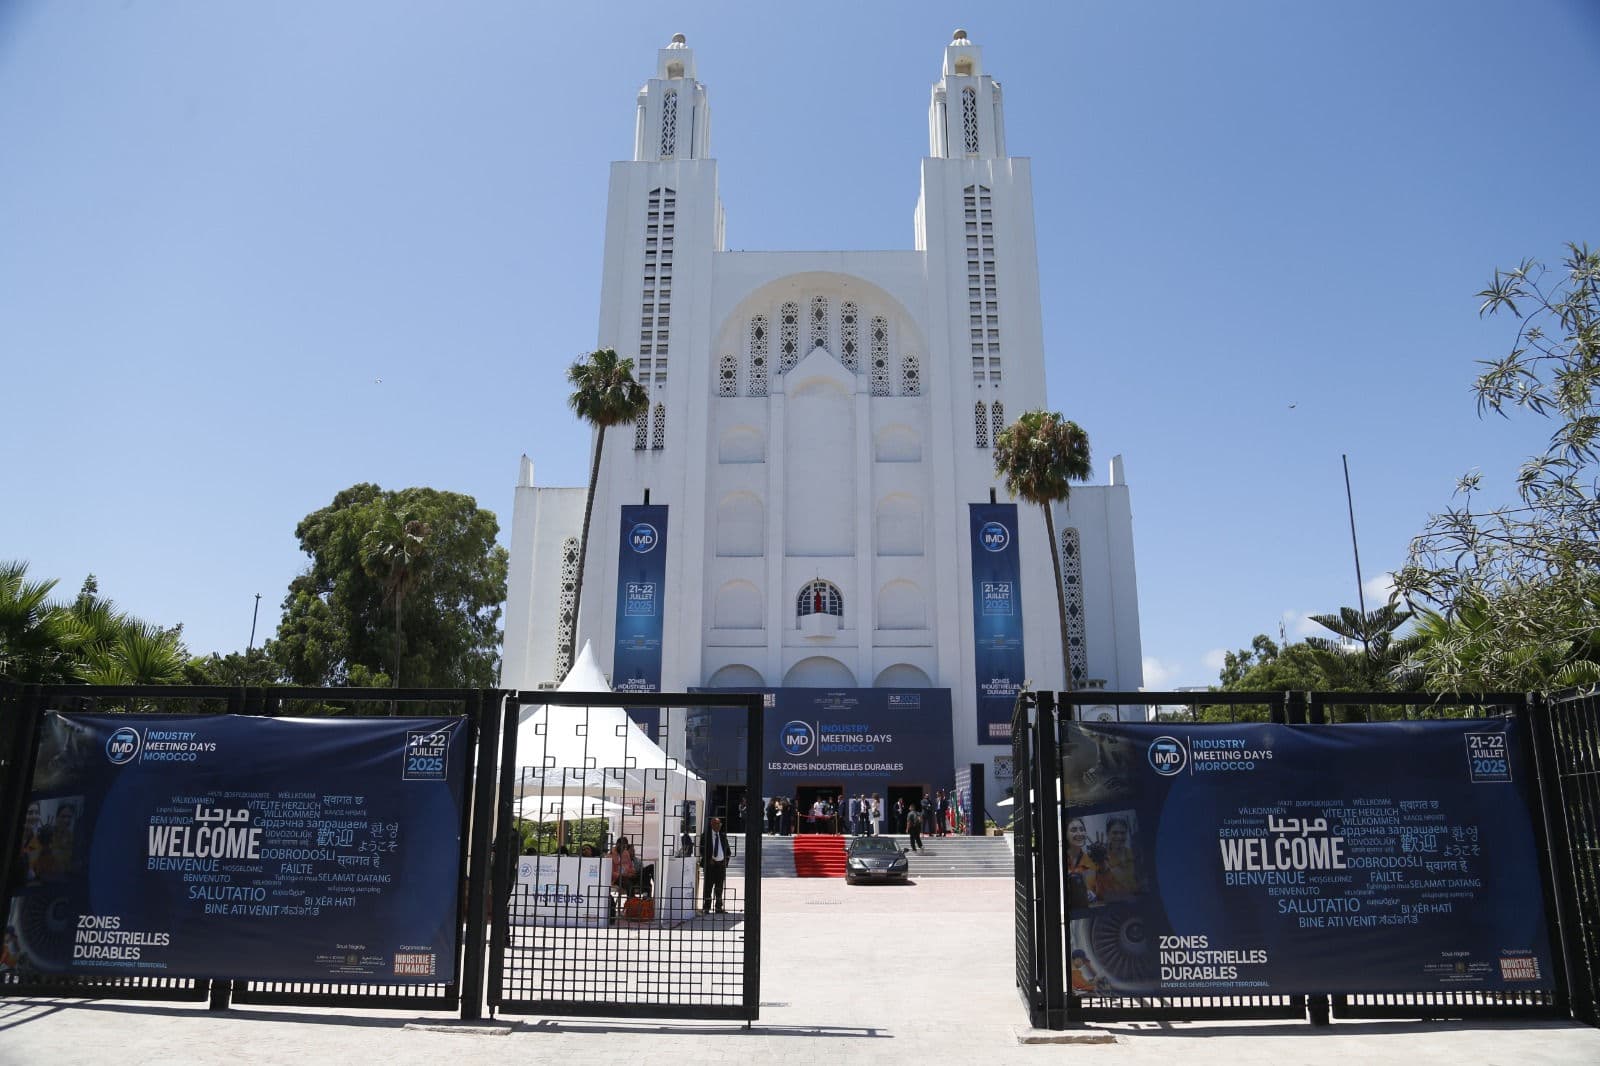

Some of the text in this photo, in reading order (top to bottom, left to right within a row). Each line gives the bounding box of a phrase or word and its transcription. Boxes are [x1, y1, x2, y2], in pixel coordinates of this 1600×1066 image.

[634, 535, 653, 544] IMD
[985, 534, 1005, 544] IMD
[628, 584, 653, 593] 21-22
[984, 584, 1010, 592] 21-22
[984, 592, 1010, 600] JUILLET
[628, 600, 652, 610] 2025
[986, 600, 1010, 608] 2025
[821, 724, 869, 732] INDUSTRY
[148, 732, 196, 740] INDUSTRY
[410, 734, 446, 746] 21-22
[786, 735, 809, 745] IMD
[820, 734, 892, 743] MEETING DAYS
[145, 742, 216, 752] MEETING DAYS
[1192, 740, 1246, 749] INDUSTRY
[1470, 736, 1504, 748] 21-22
[112, 742, 134, 753] IMD
[410, 748, 444, 756] JUILLET
[821, 744, 874, 752] MOROCCO
[144, 752, 197, 761] MOROCCO
[1155, 752, 1180, 764] IMD
[1194, 750, 1273, 760] MEETING DAYS
[1472, 749, 1504, 758] JUILLET
[408, 758, 443, 770] 2025
[768, 762, 904, 771] LES ZONES INDUSTRIELLES DURABLES
[1194, 761, 1255, 771] MOROCCO
[1473, 760, 1507, 773] 2025
[281, 801, 321, 810] HERZLICH
[194, 804, 250, 828] مرحبا
[264, 810, 320, 819] WILLKOMMEN
[1358, 808, 1399, 817] HERZLICH
[150, 816, 194, 825] BEM VINDA
[254, 816, 368, 830] Сардэчна запрашаем
[1342, 816, 1400, 826] WILLKOMMEN
[1268, 814, 1328, 838] مرحبا
[1332, 825, 1448, 837] Сардэчна запрашаем
[1220, 828, 1270, 838] BEM VINDA
[148, 825, 263, 859] WELCOME
[358, 840, 398, 852] ようこそ
[1220, 837, 1347, 871] WELCOME
[1443, 844, 1481, 857] ようこそ
[147, 858, 220, 872] BIENVENUE
[184, 874, 231, 883] BENVENUTO
[318, 874, 392, 883] SELAMAT DATANG
[1225, 871, 1306, 886] BIENVENUE
[1409, 878, 1481, 888] SELAMAT DATANG
[188, 886, 266, 902] SALUTATIO
[1268, 886, 1320, 896] BENVENUTO
[204, 903, 280, 916] BINE ATI VENIT
[1278, 898, 1360, 914] SALUTATIO
[77, 915, 120, 929] ZONES
[1298, 916, 1377, 928] BINE ATI VENIT
[75, 930, 170, 946] INDUSTRIELLES
[1159, 936, 1209, 949] ZONES
[73, 945, 141, 960] DURABLES
[1160, 950, 1268, 965] INDUSTRIELLES
[395, 954, 430, 964] INDUSTRIE
[1500, 958, 1534, 969] INDUSTRIE
[394, 964, 404, 974] DU
[404, 964, 430, 974] MAROC
[1161, 966, 1238, 980] DURABLES
[1502, 968, 1513, 979] DU
[1514, 968, 1536, 979] MAROC
